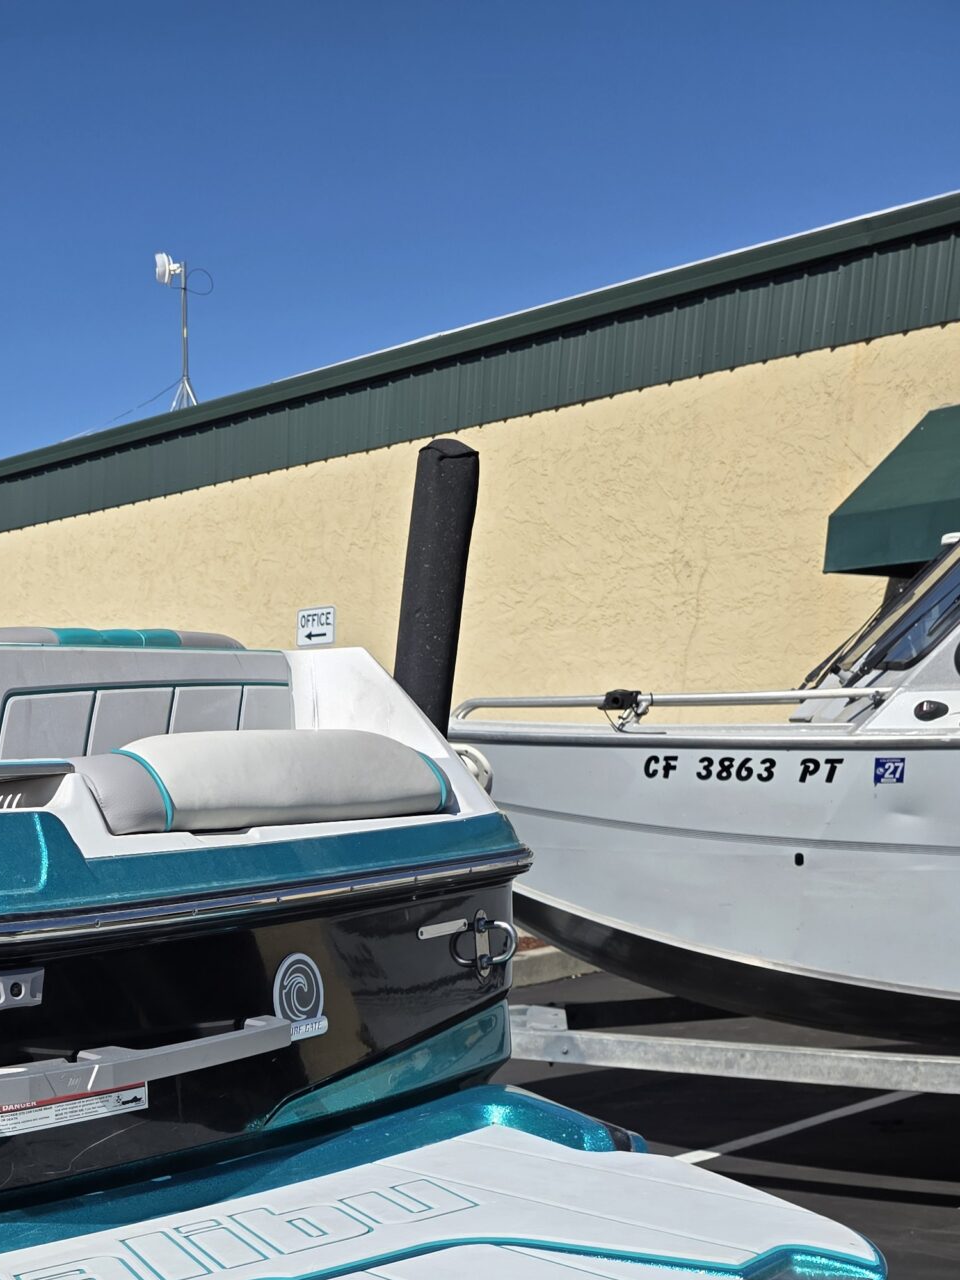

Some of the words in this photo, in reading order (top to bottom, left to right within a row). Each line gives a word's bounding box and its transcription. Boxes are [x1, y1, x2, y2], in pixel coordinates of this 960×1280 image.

[301, 611, 332, 628] OFFICE
[644, 755, 679, 779] CF
[696, 756, 777, 783] 3863
[799, 758, 844, 784] PT
[884, 762, 904, 779] 27
